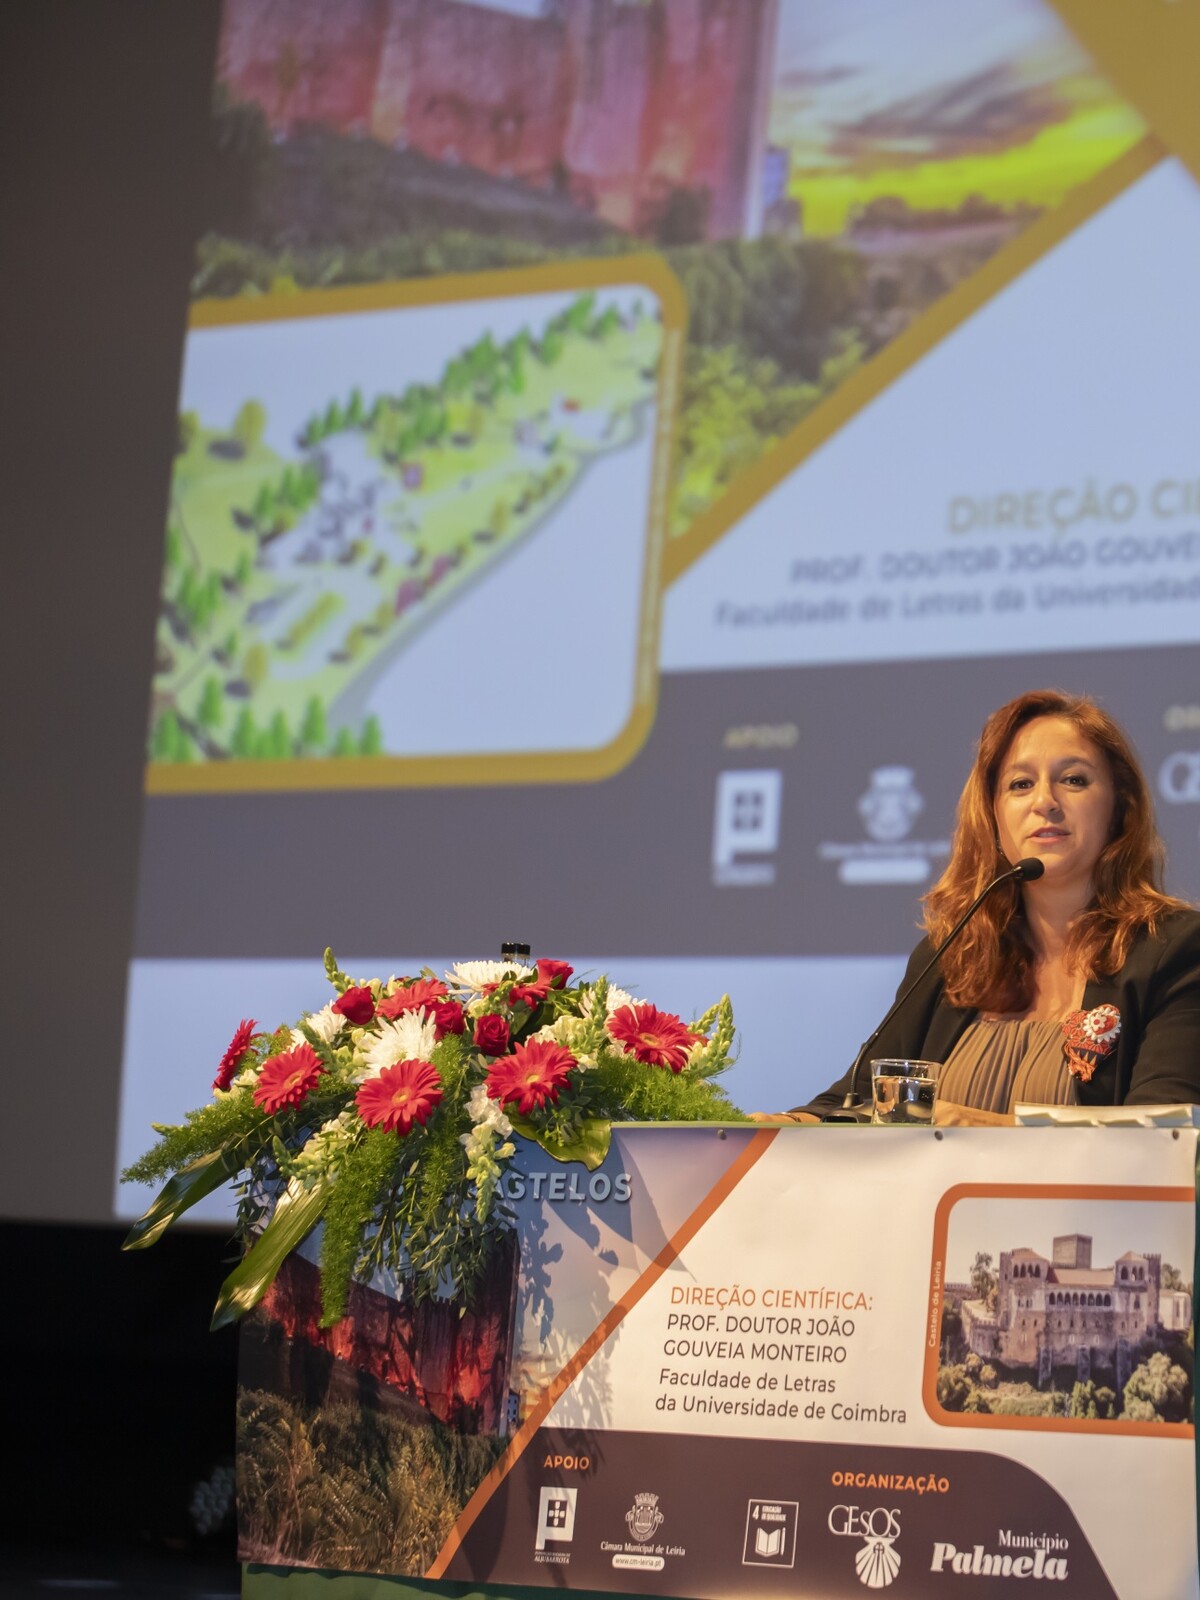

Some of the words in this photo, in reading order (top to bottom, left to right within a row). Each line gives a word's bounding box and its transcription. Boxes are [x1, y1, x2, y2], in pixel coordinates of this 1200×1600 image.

[946, 475, 1139, 535] DIREÇÃO
[933, 1261, 942, 1289] Leiria
[670, 1285, 757, 1310] DIREÇÃO
[762, 1287, 874, 1311] CIENTÍFICA:
[932, 1292, 940, 1306] de
[667, 1313, 720, 1332] PROF.
[725, 1316, 802, 1335] DOUTOR
[806, 1315, 855, 1337] JOÃO
[928, 1307, 939, 1347] Castelo
[663, 1339, 745, 1359] GOUVEIA
[751, 1343, 847, 1363] MONTEIRO
[659, 1368, 751, 1389] Faculdade
[756, 1372, 778, 1390] de
[784, 1374, 836, 1393] Letras
[655, 1393, 676, 1411] da
[683, 1395, 799, 1418] Universidade
[804, 1401, 826, 1419] de
[831, 1403, 907, 1424] Coimbra
[543, 1455, 590, 1470] APOIO
[831, 1471, 950, 1495] ORGANIZAÇÃO
[752, 1504, 760, 1520] 4
[600, 1541, 623, 1552] Câmara
[624, 1542, 655, 1555] Municipal
[655, 1544, 665, 1555] de
[666, 1545, 686, 1556] Leiria
[998, 1529, 1069, 1552] Município
[930, 1542, 1069, 1580] Palmela
